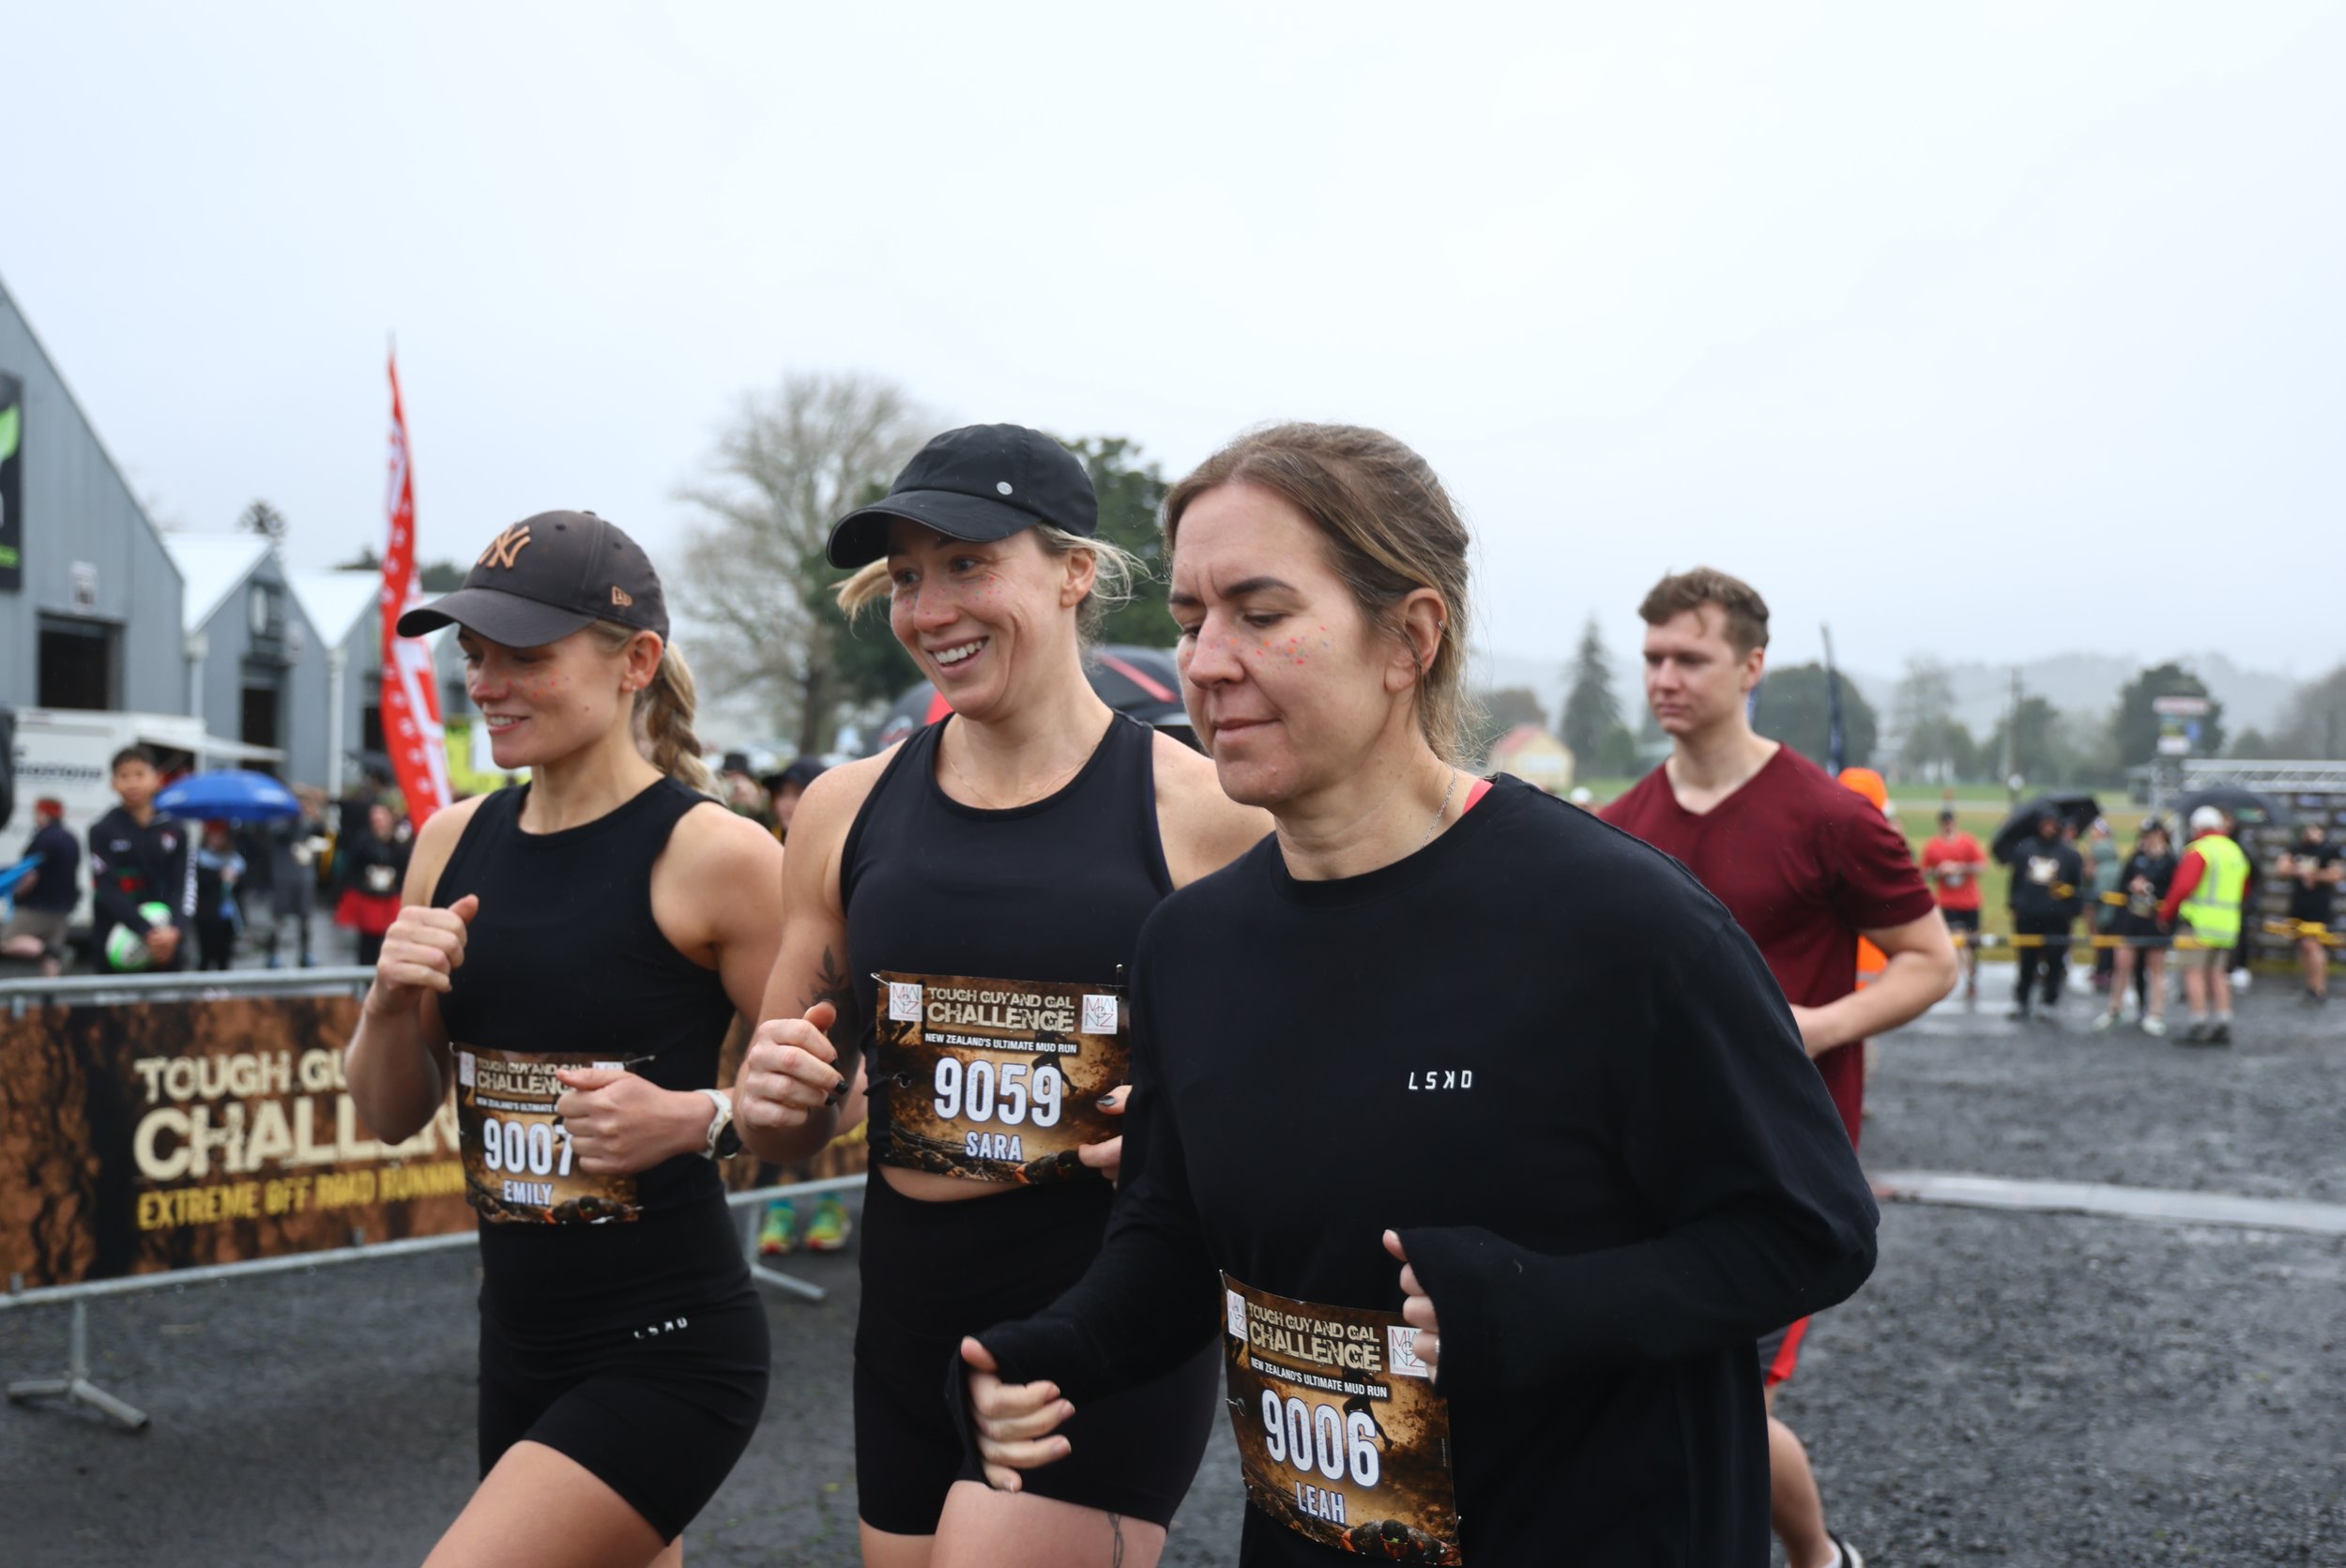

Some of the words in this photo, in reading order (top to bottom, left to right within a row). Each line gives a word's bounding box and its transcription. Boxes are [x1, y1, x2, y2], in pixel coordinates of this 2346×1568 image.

[927, 1002, 1074, 1032] CHALLENGE
[928, 987, 977, 1002] TOUGH
[980, 991, 1010, 1005] GUY
[1011, 993, 1042, 1007] AND
[1044, 996, 1074, 1009] GAL
[924, 1033, 945, 1043] NEW
[946, 1034, 991, 1047] ZEALAND'S
[993, 1039, 1034, 1051] ULTIMATE
[1035, 1043, 1056, 1052] MUD
[1058, 1043, 1077, 1054] RUN
[134, 1049, 292, 1103] TOUGH
[531, 1063, 558, 1075] AND
[1409, 1070, 1472, 1089] LSKD
[934, 1057, 1062, 1127] 9059
[483, 1118, 573, 1176] 9007
[966, 1131, 1023, 1161] SARA
[138, 1180, 260, 1230] EXTREME
[264, 1176, 313, 1215] OFF
[503, 1180, 553, 1205] EMILY
[1247, 1302, 1283, 1326] TOUGH
[1286, 1315, 1313, 1333] GUY
[1314, 1320, 1344, 1338] AND
[1348, 1325, 1379, 1343] GAL
[1249, 1320, 1381, 1371] CHALLENGE
[1251, 1357, 1263, 1371] NEW
[1265, 1362, 1302, 1383] ZEALAND'S
[1304, 1375, 1343, 1392] ULTIMATE
[1344, 1382, 1364, 1394] MUD
[1367, 1385, 1387, 1397] RUN
[1262, 1390, 1379, 1487] 9006
[1295, 1481, 1346, 1525] LEAH
